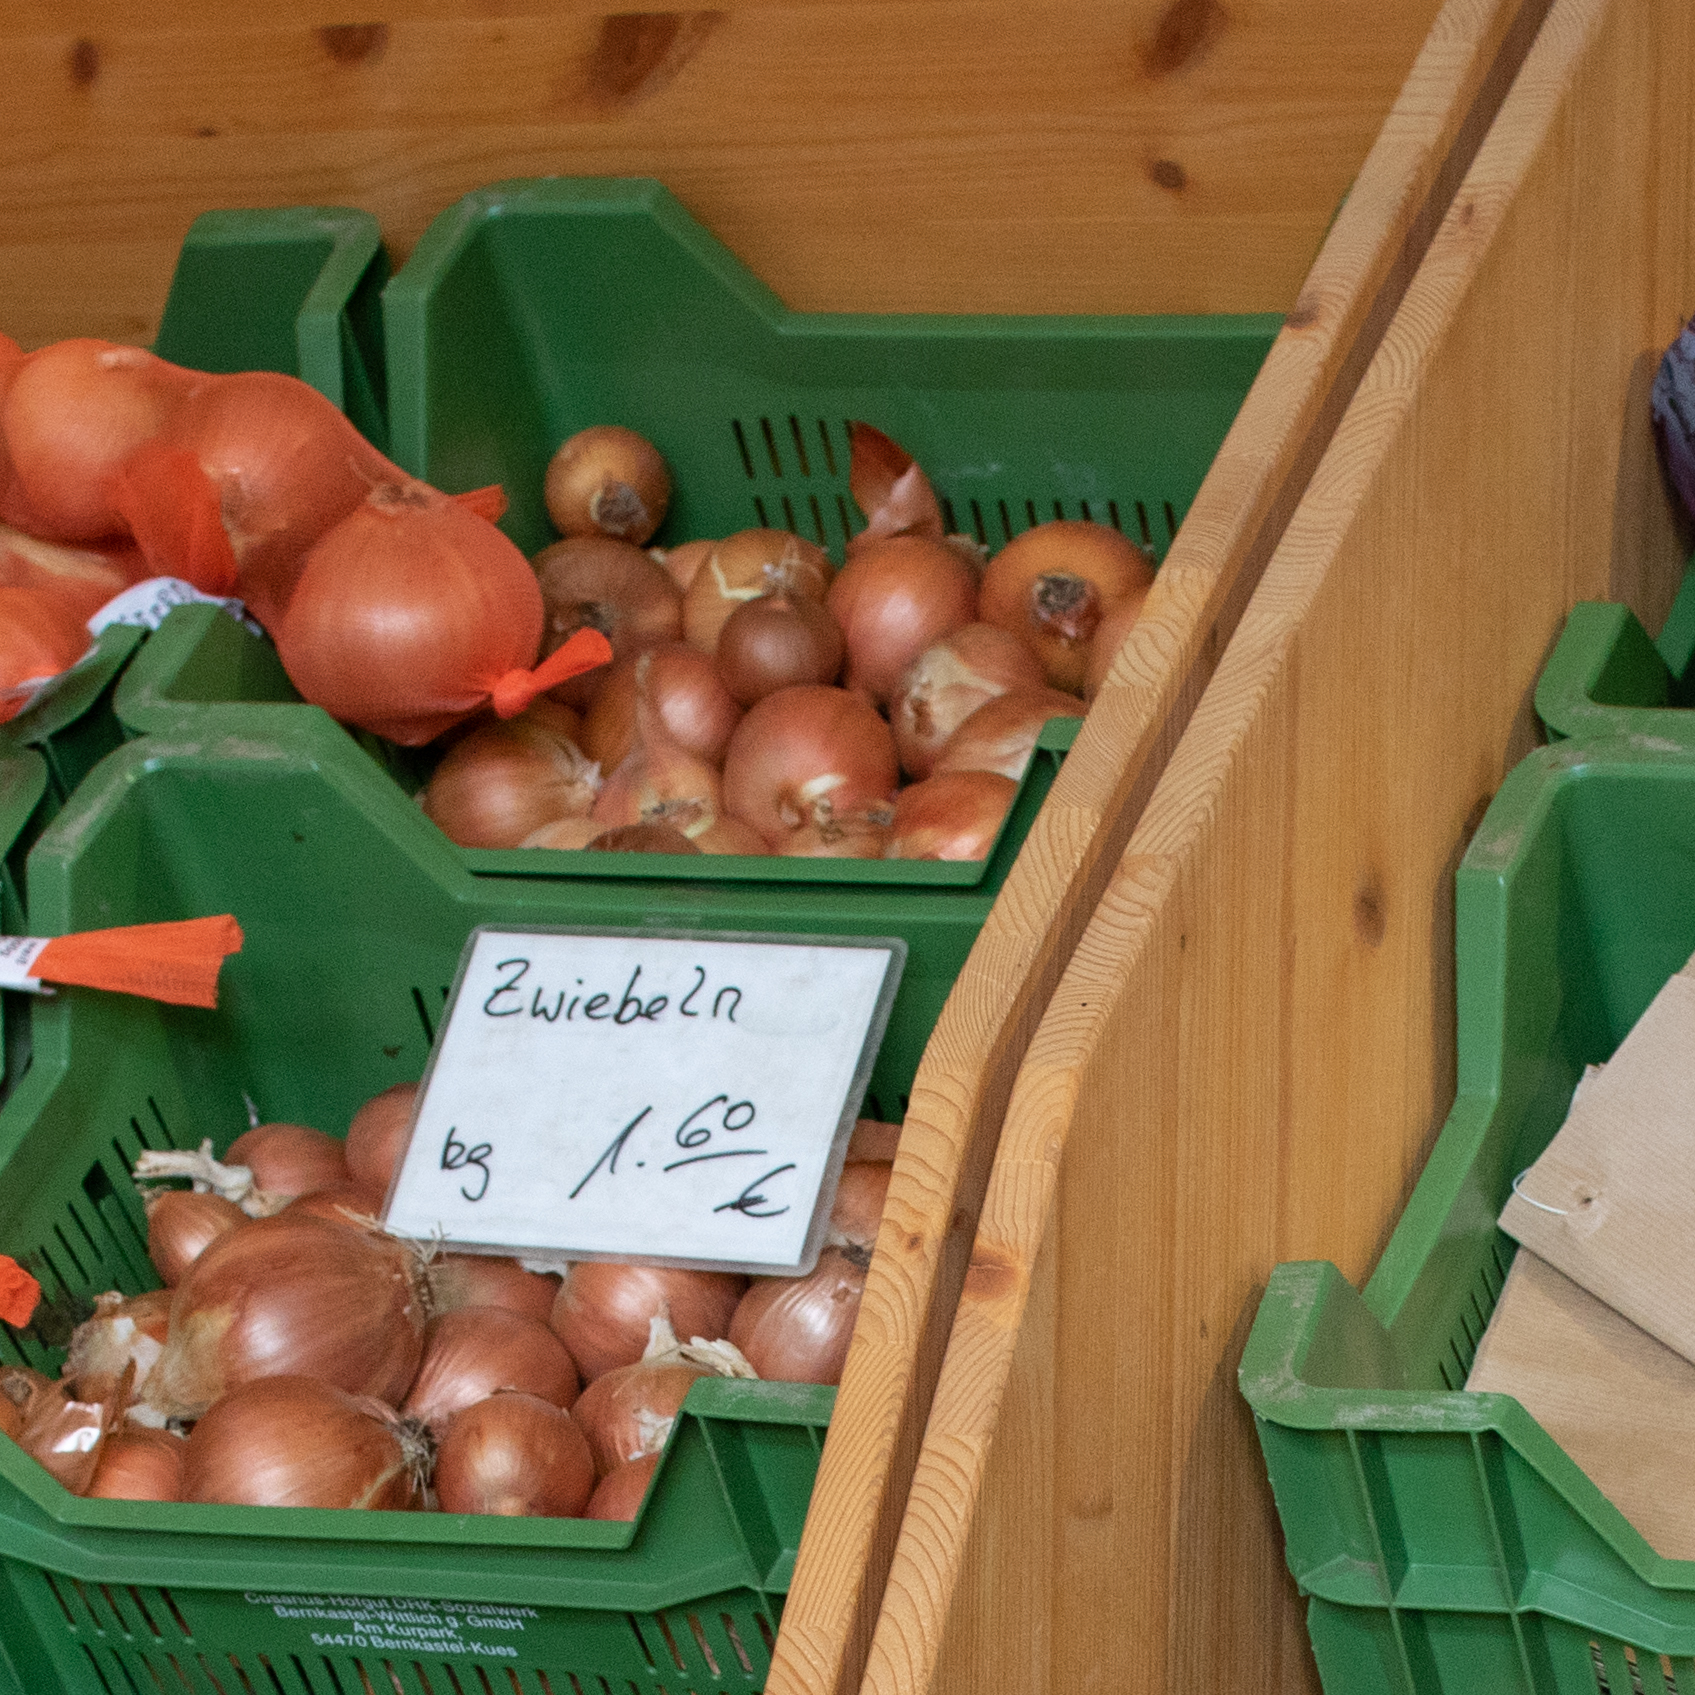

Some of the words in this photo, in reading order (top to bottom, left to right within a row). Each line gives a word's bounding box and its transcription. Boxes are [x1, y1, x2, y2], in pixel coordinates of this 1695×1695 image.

[483, 958, 743, 1025] Zwiebeln
[440, 1126, 493, 1202] kg
[273, 1604, 442, 1626] Bernkastel-Wittlich
[466, 1614, 525, 1631] GmbH
[352, 1620, 383, 1635] Am
[310, 1632, 368, 1648] 54470
[369, 1634, 519, 1658] Bernkastel-Kues
